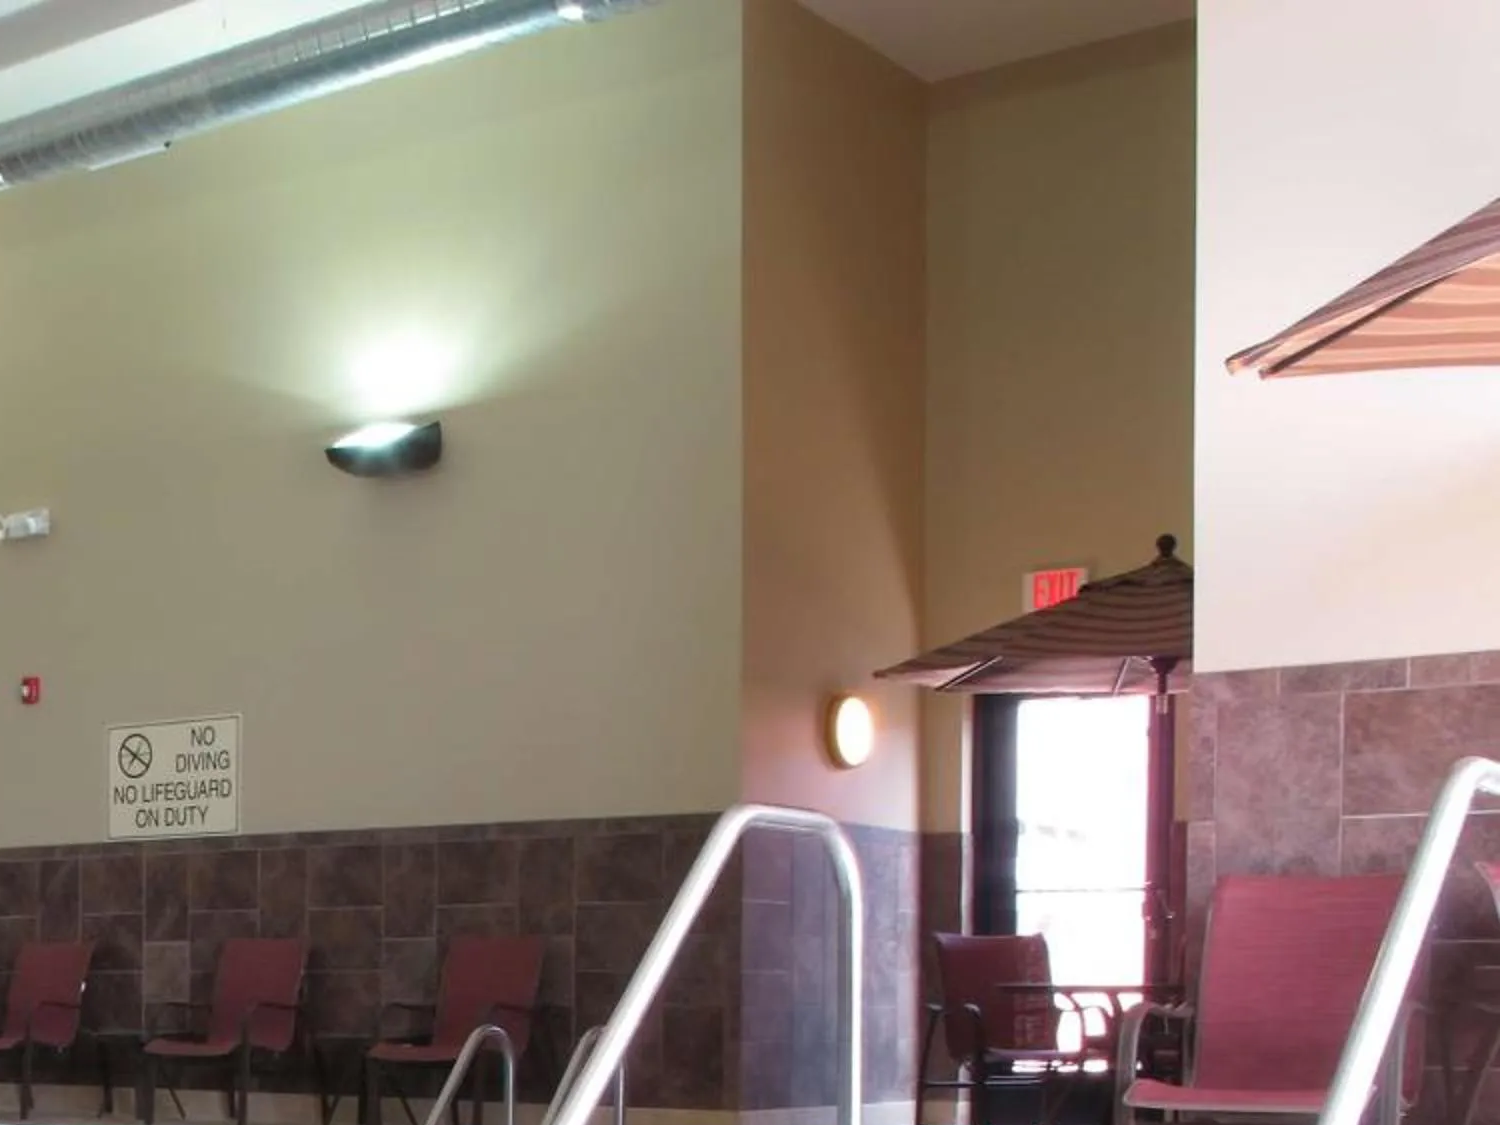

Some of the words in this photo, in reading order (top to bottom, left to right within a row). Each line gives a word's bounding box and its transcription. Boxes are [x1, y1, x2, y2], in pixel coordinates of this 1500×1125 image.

[191, 725, 215, 746] NO
[175, 750, 231, 773] DIVING
[113, 785, 137, 805] NO
[141, 778, 232, 803] LIFEGUARD
[135, 809, 159, 828] ON
[164, 805, 209, 827] DUTY
